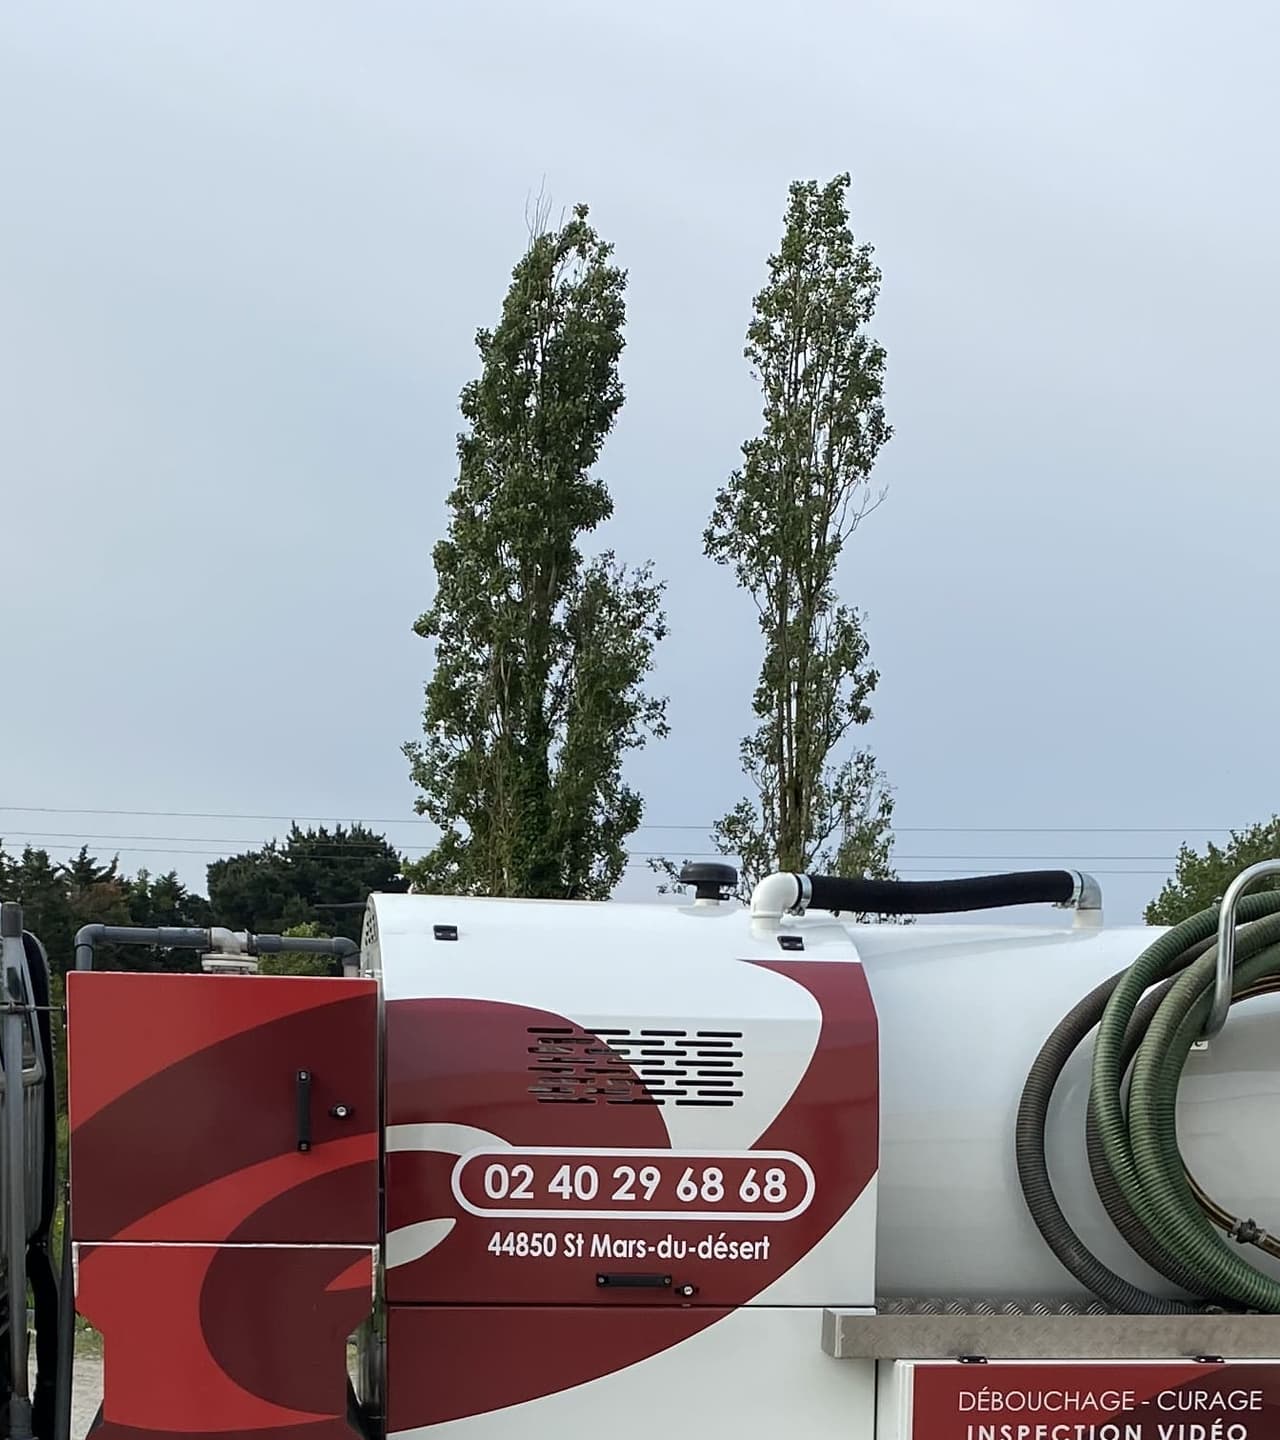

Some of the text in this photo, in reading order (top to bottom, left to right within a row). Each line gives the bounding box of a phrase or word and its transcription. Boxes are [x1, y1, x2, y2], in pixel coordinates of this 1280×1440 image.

[484, 1163, 788, 1203] 02 40 29 68 68
[487, 1231, 771, 1260] 44850 St Mars-du-désert
[958, 1386, 1135, 1412] DÉBOUCHAGE
[1156, 1390, 1263, 1411] CURAGE
